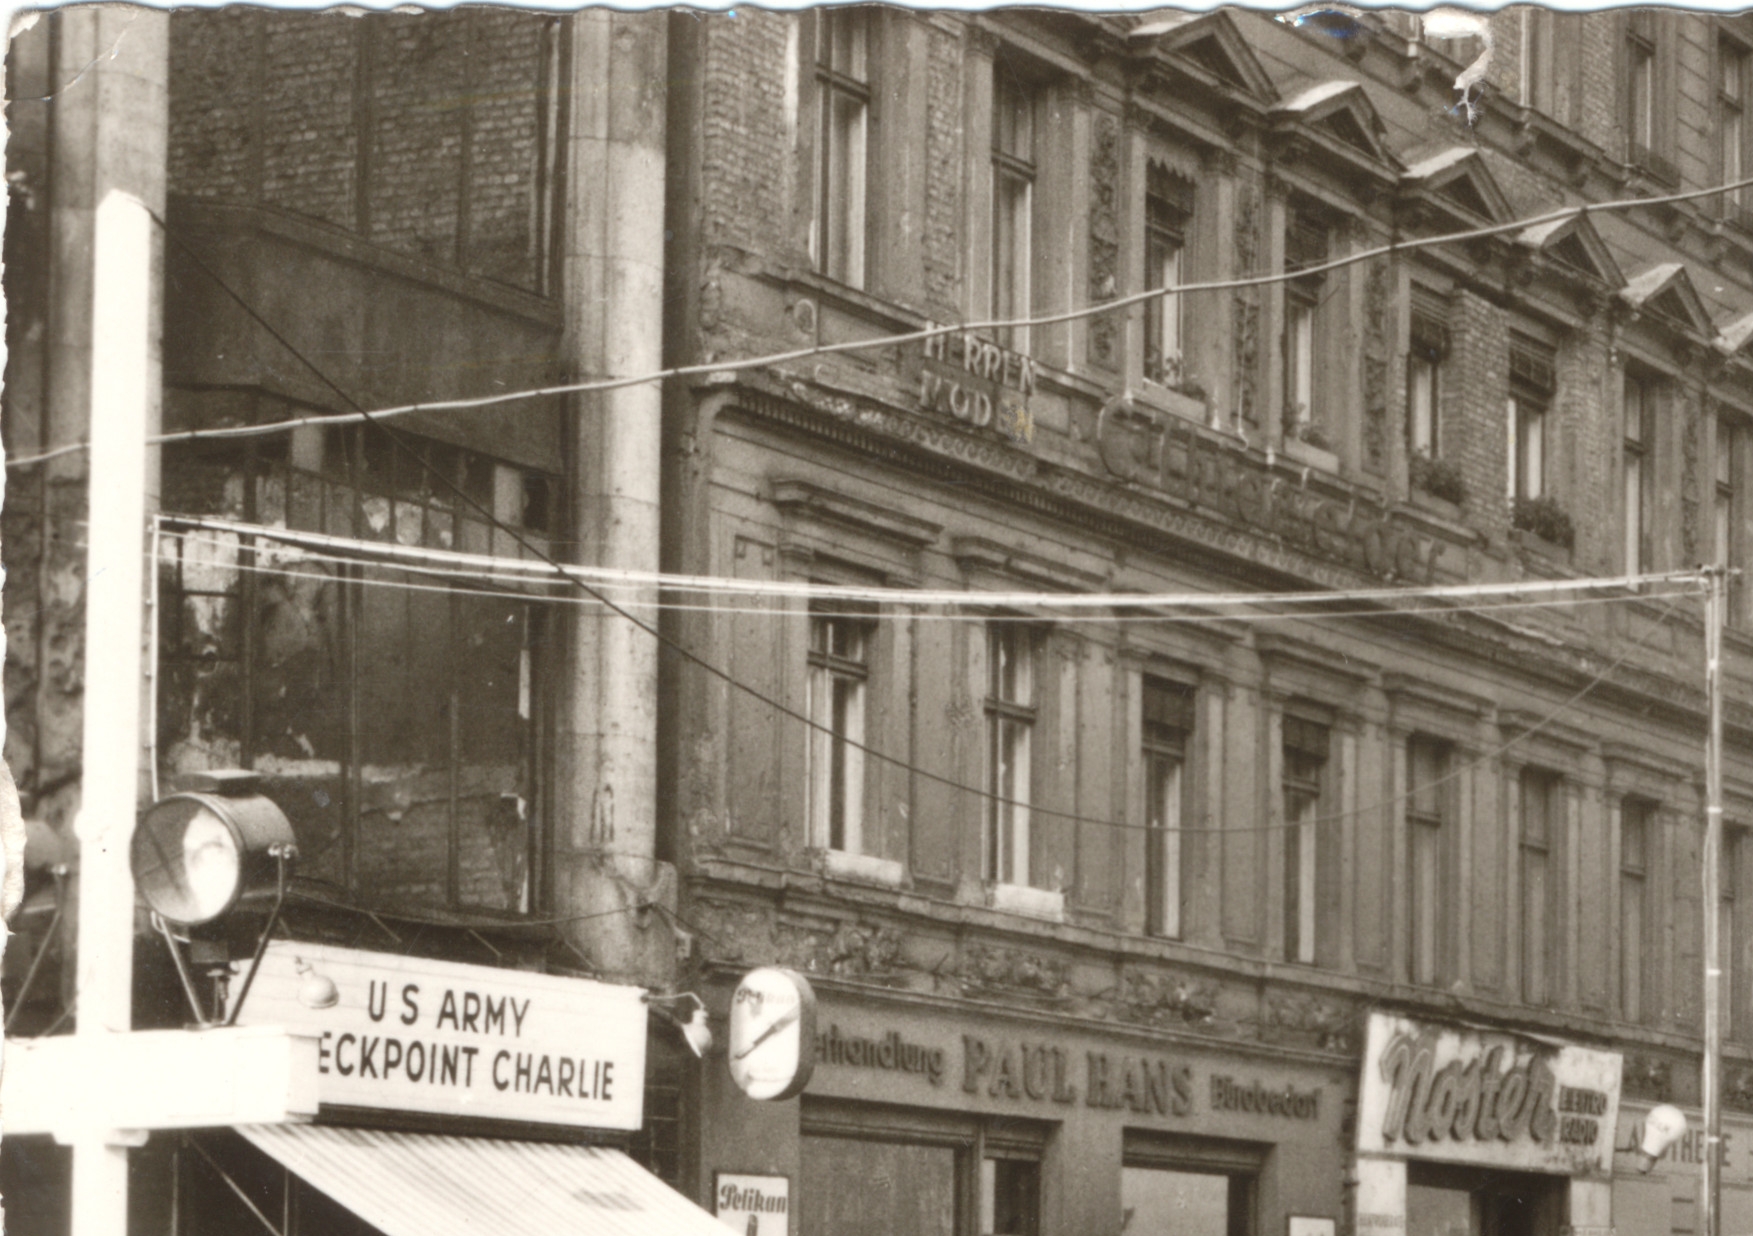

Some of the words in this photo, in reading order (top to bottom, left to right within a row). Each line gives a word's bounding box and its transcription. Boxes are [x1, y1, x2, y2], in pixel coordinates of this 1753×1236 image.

[924, 320, 1036, 396] HRREN
[436, 989, 531, 1038] ARMY
[318, 1031, 479, 1088] ECKPOINT
[492, 1049, 614, 1102] CHARLIE
[962, 1033, 1077, 1105] PAUL
[1085, 1051, 1193, 1118] HANS
[1558, 1113, 1600, 1147] RADIO
[1627, 1118, 1733, 1168] ATHEE
[719, 1182, 787, 1214] Pelikan
